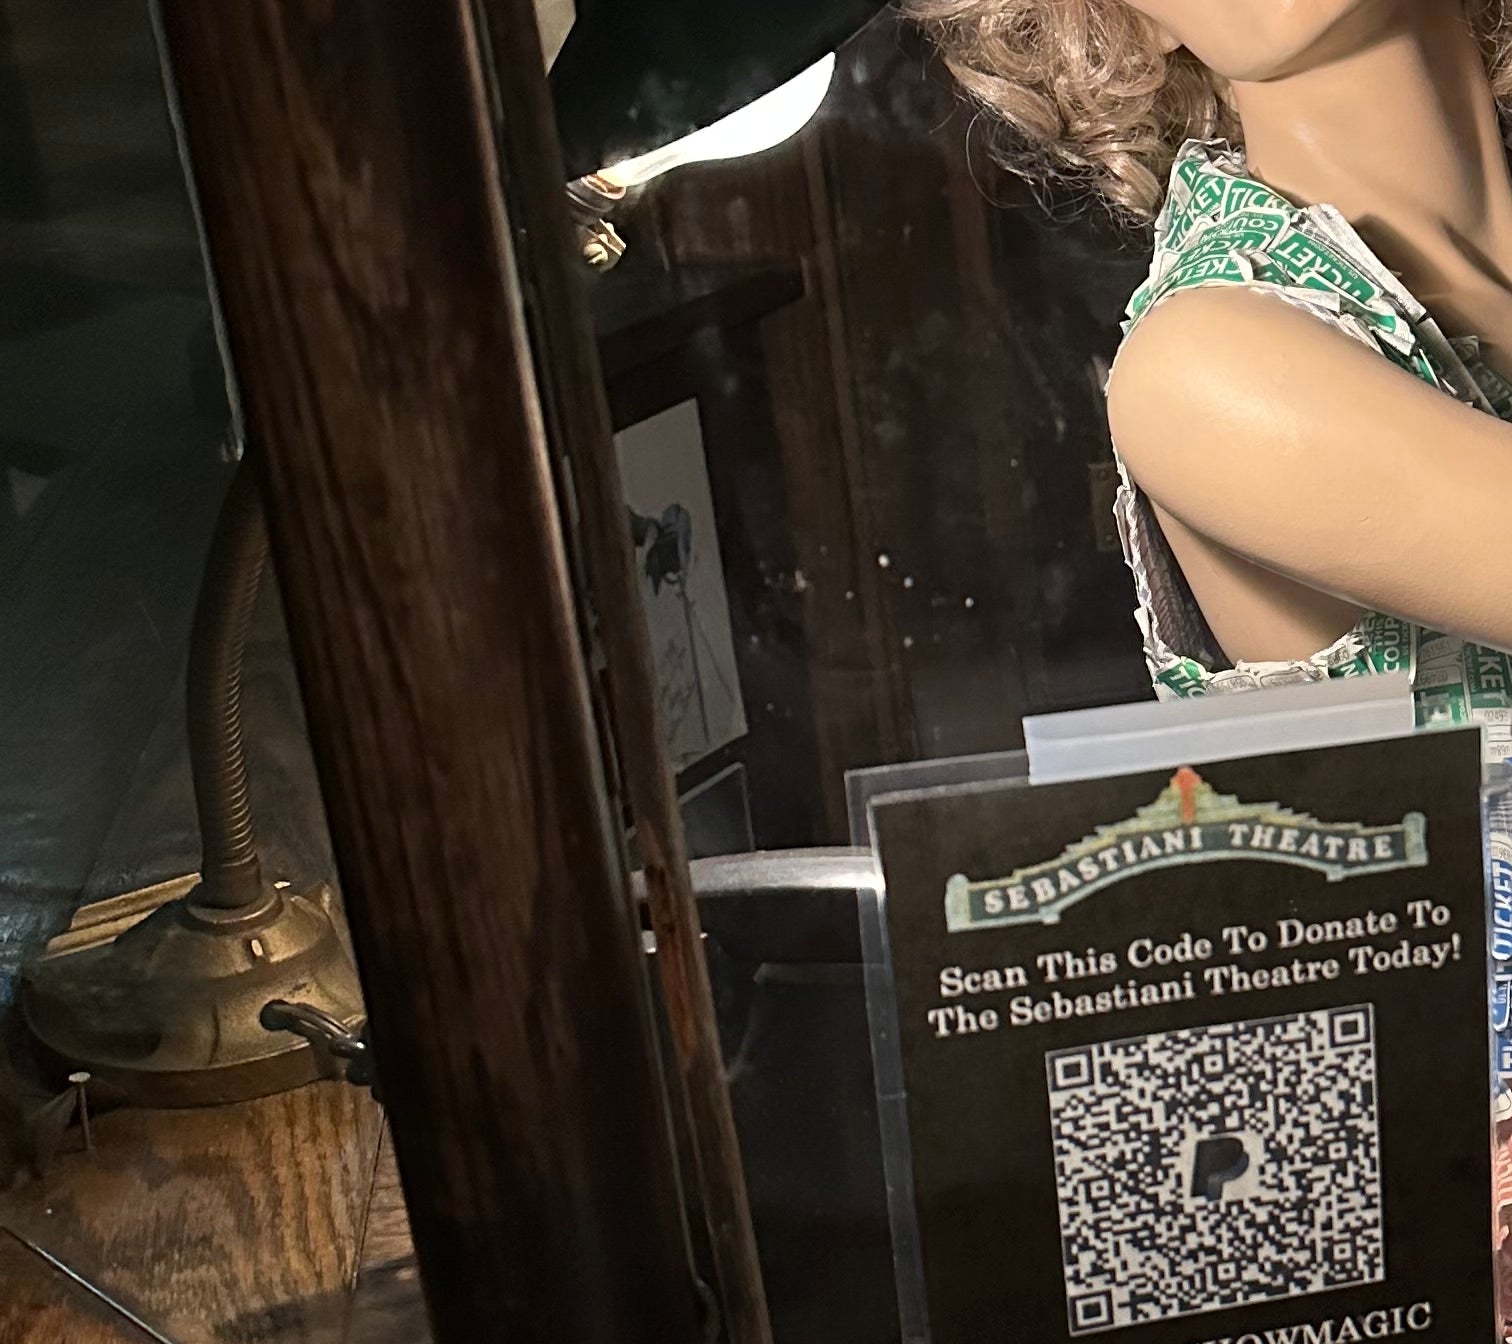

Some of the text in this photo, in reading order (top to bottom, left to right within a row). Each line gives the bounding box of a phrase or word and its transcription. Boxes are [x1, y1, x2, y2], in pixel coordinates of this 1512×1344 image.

[1231, 187, 1285, 213] TICK
[1383, 615, 1400, 674] COUP
[1478, 645, 1507, 702] KET
[983, 824, 1392, 914] SEBASTIANI THEATRE
[928, 932, 1462, 1039] The Sebastiani Theatre Today!
[940, 899, 1450, 999] Scan This Code To Donate To
